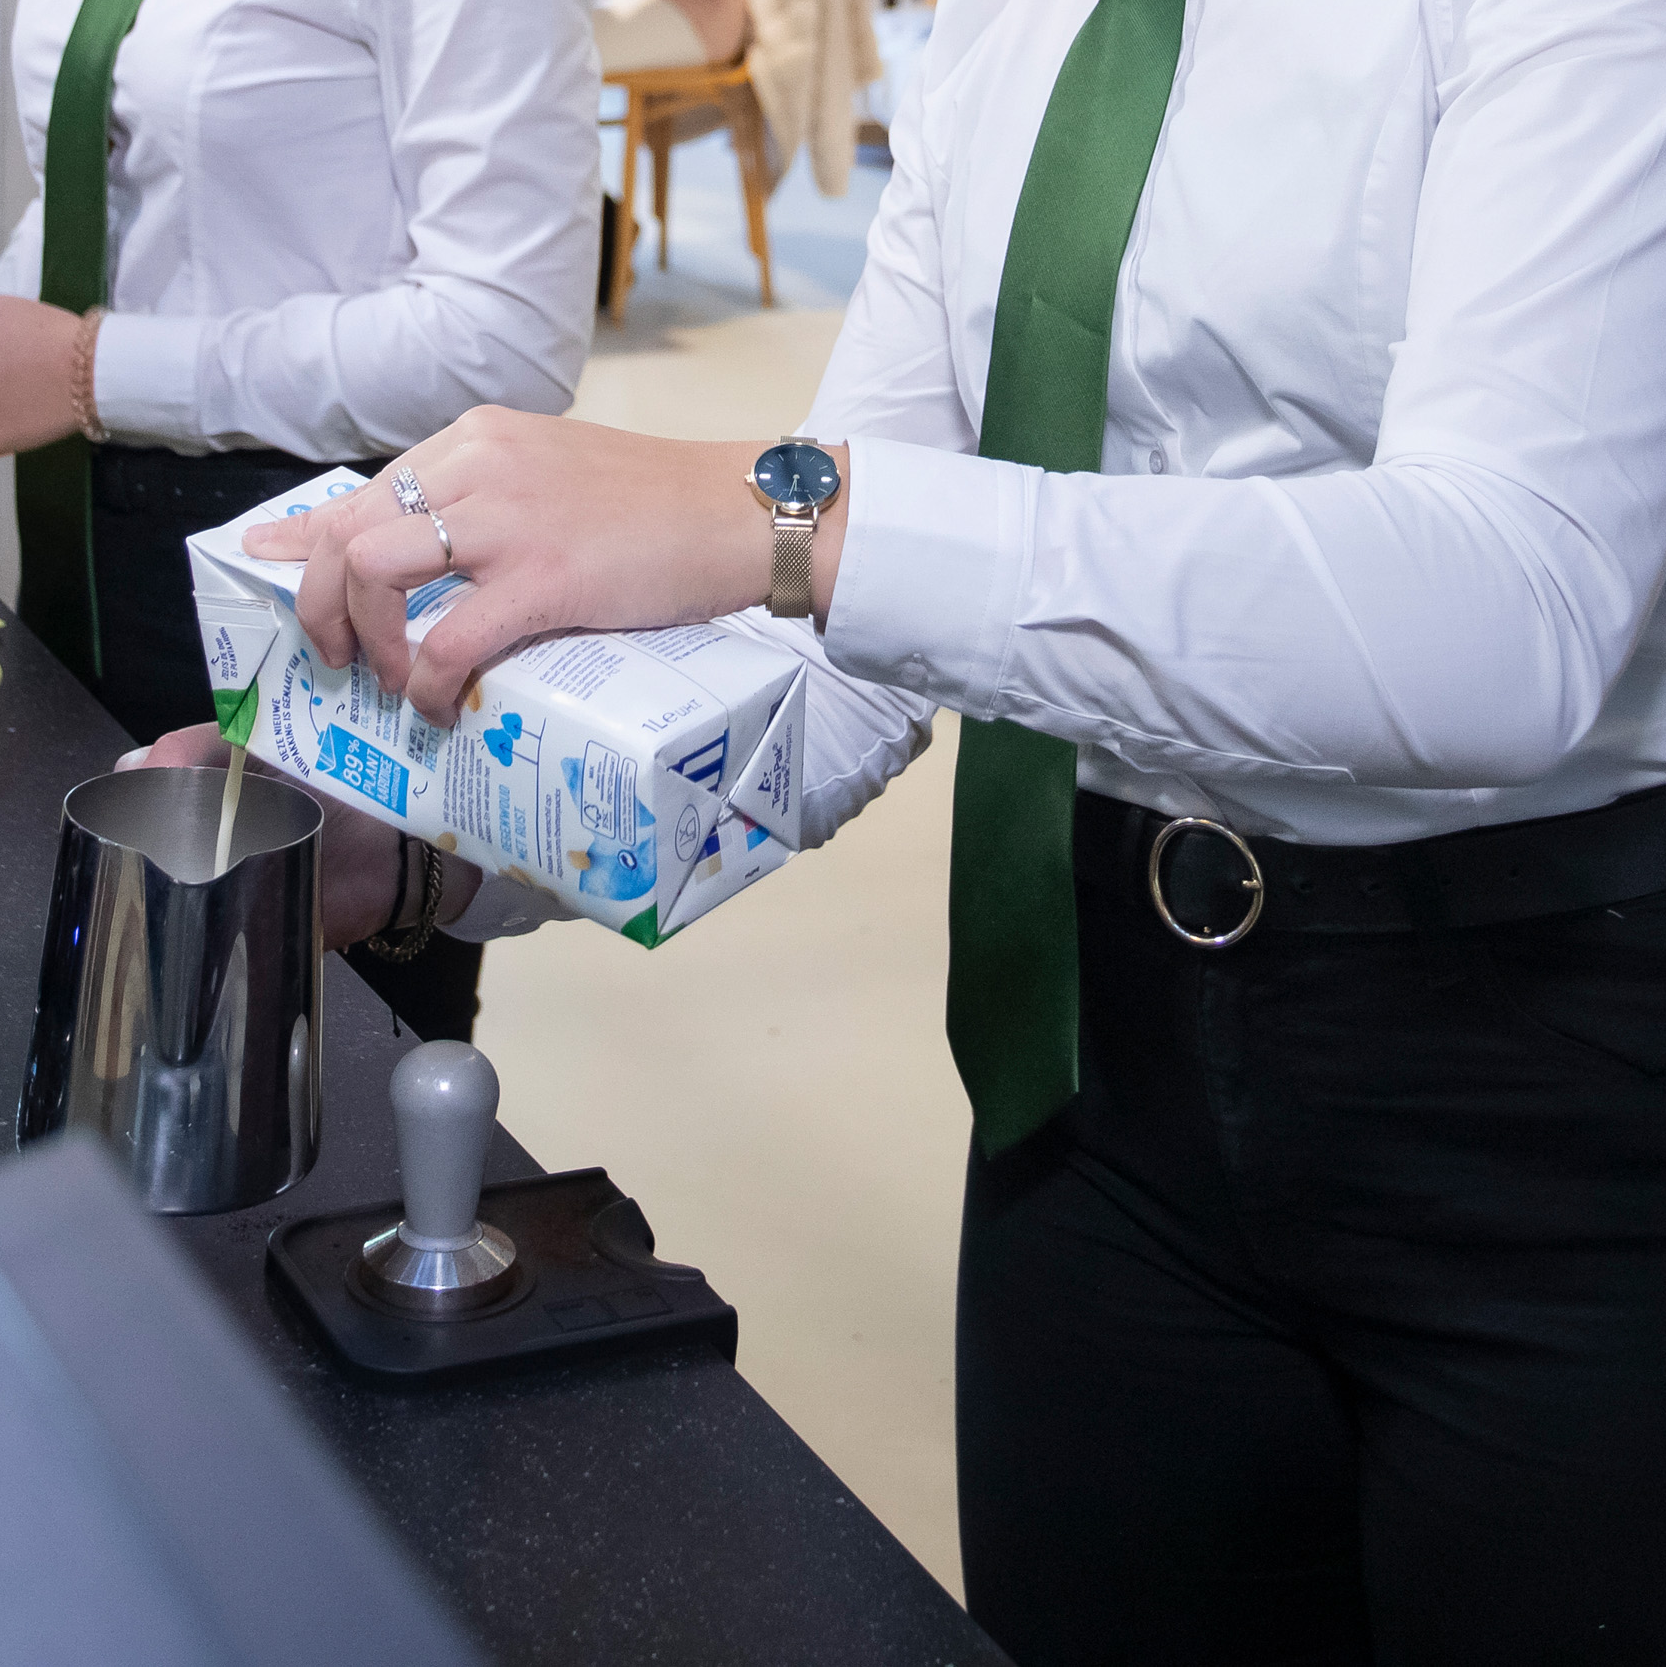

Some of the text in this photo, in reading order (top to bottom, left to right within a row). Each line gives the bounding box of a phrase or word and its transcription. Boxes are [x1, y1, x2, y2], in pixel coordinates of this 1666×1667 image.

[271, 698, 289, 762] DEZE NIEUWE
[282, 652, 309, 777] VERPAKKING IS GEMAAKT VAN
[342, 738, 363, 787] 89%
[424, 724, 439, 772] RECYC
[785, 723, 793, 765] Aseptic
[362, 746, 379, 796] PLANT
[772, 773, 782, 809] Tetra
[781, 785, 791, 816] Tetra
